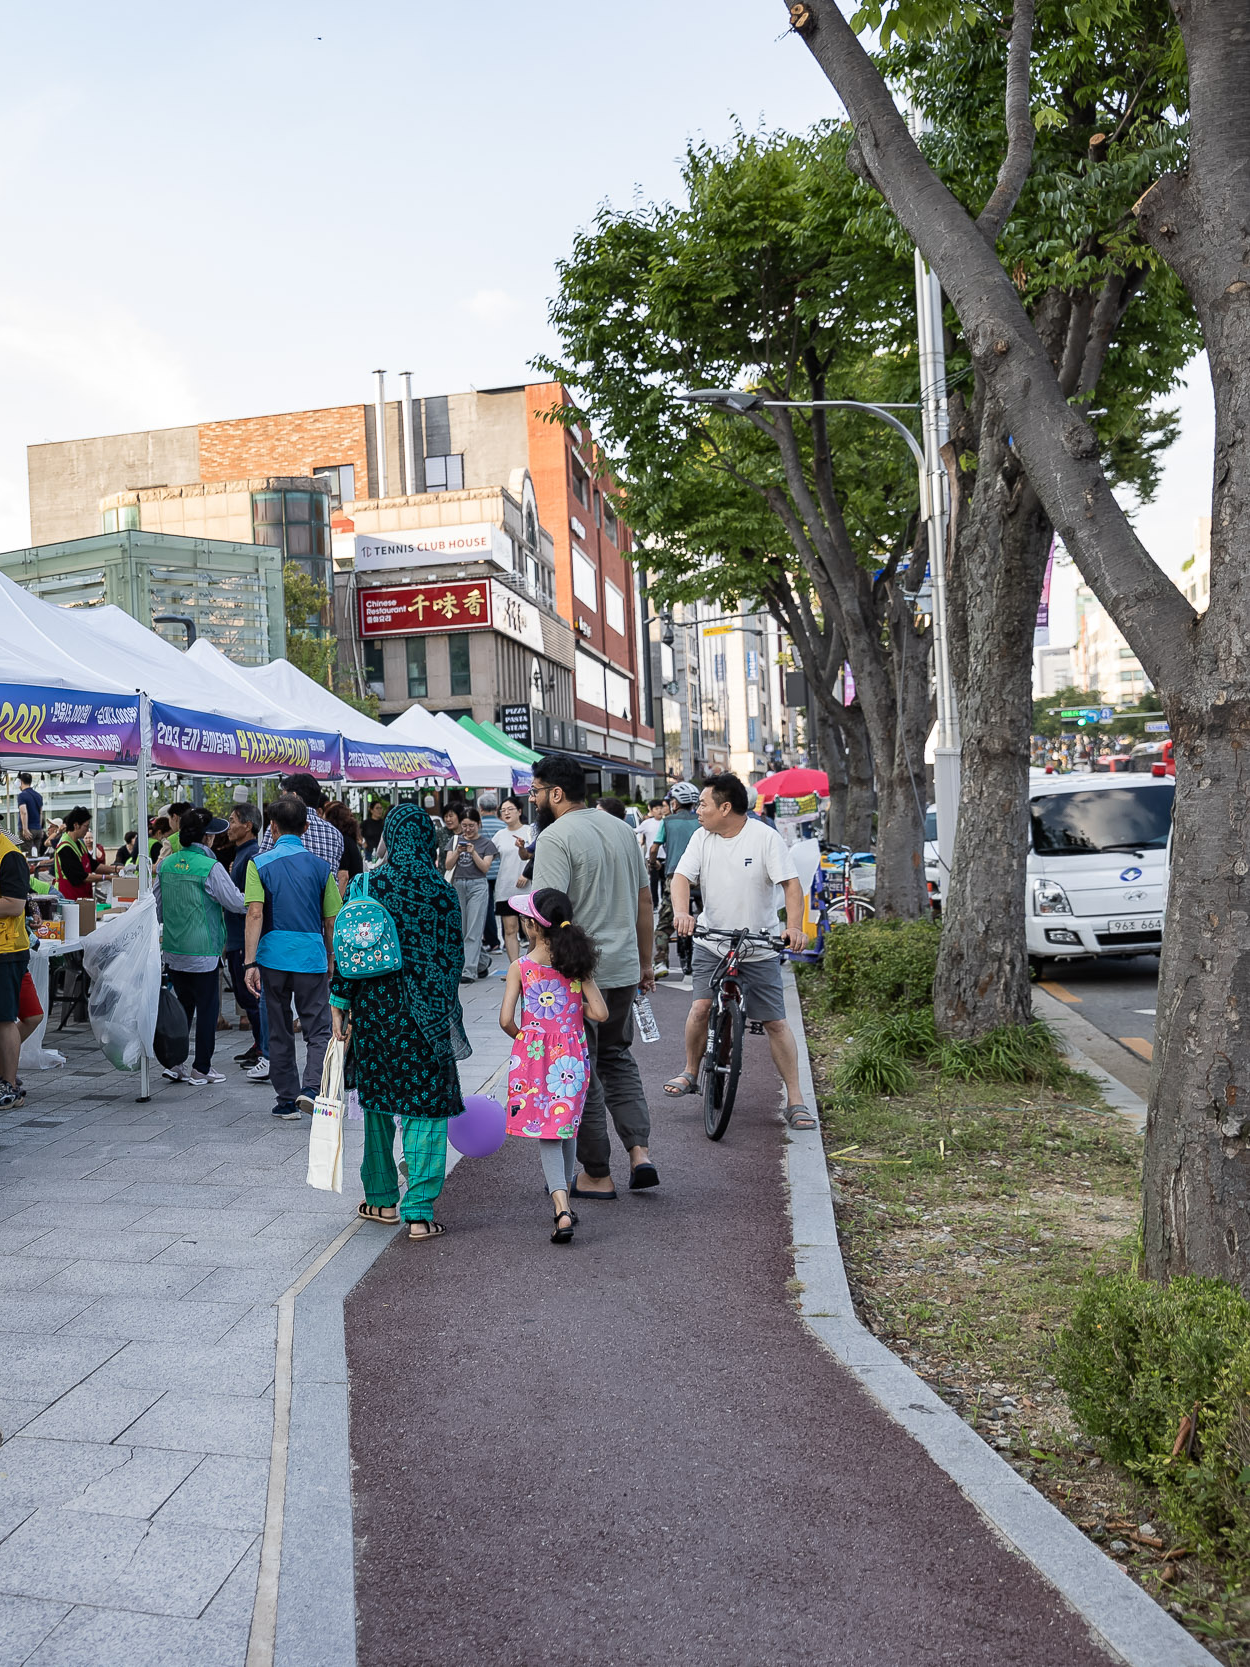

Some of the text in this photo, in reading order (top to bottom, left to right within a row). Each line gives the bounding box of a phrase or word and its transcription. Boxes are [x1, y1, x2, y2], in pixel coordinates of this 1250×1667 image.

[374, 537, 487, 556] TENNIS CLUB HOUSE
[365, 600, 397, 608] Chinese
[407, 588, 485, 621] 千味香
[366, 605, 407, 616] Restaurant
[505, 707, 527, 715] PIZZA
[505, 715, 528, 724] PASTA
[505, 724, 528, 732] STEAK
[182, 728, 200, 751] 군자
[508, 732, 526, 740] WINE
